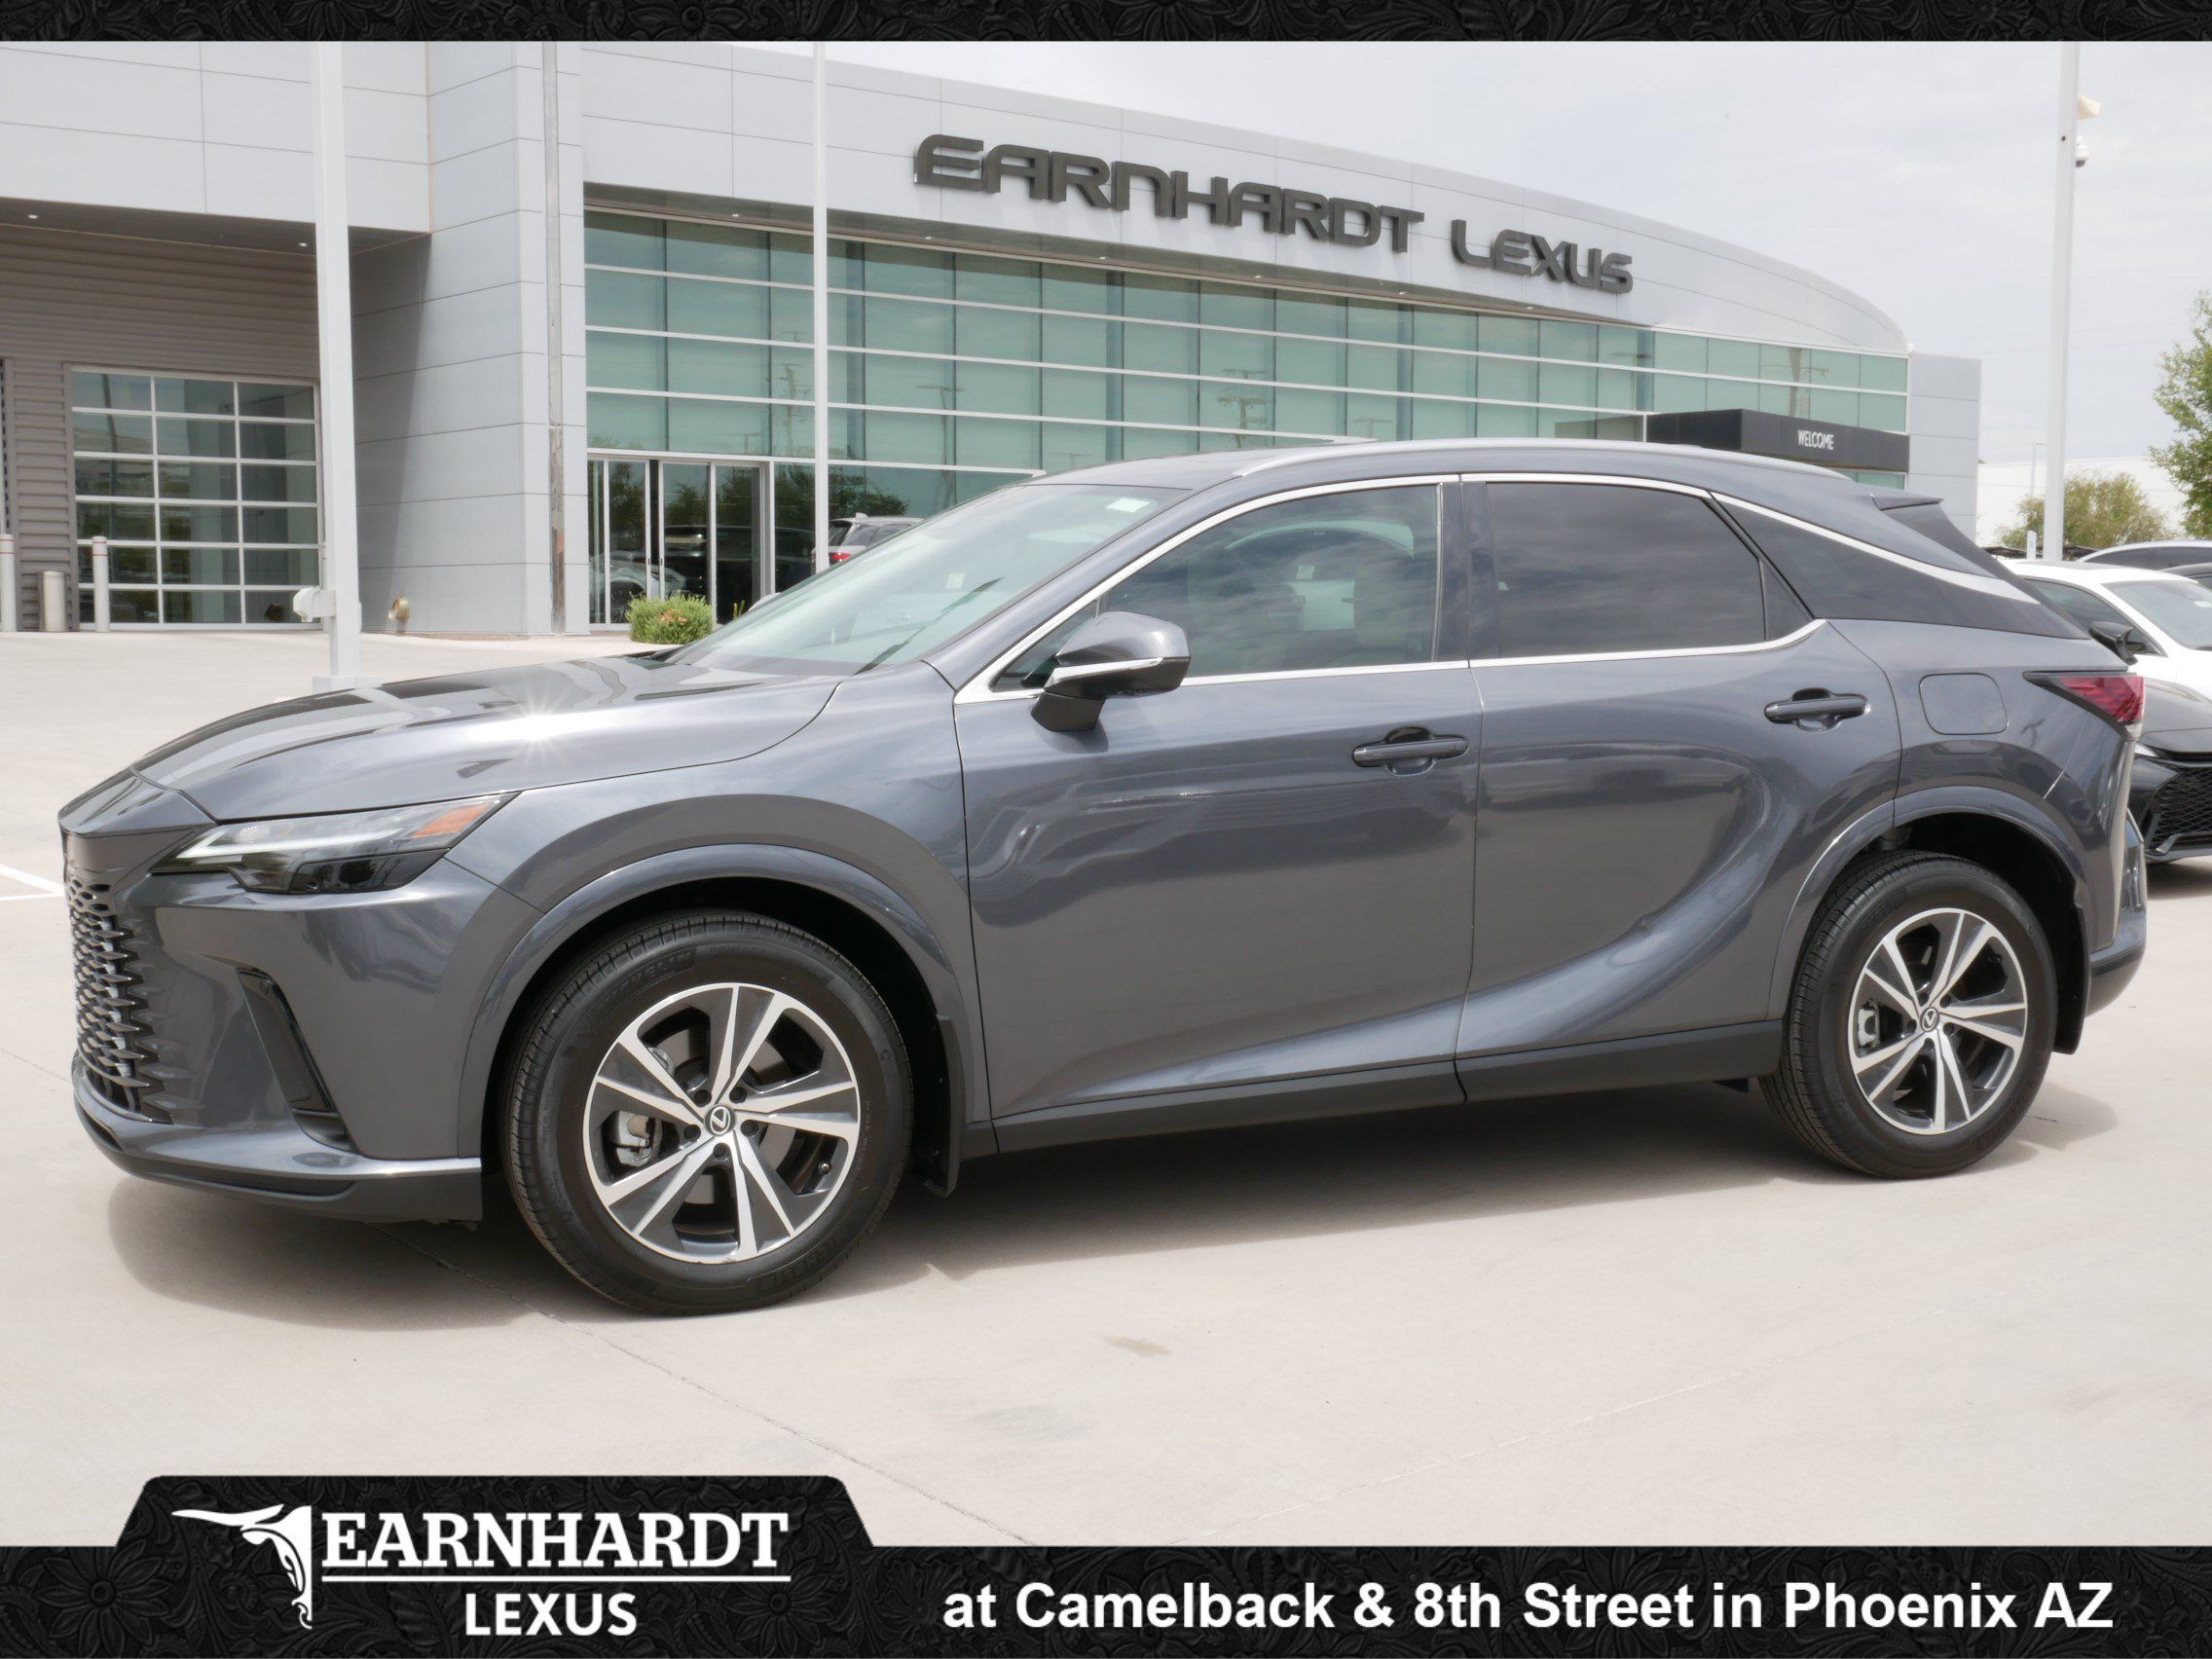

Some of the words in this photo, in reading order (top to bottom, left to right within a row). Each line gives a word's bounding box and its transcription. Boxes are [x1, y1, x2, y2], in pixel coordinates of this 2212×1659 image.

[913, 134, 1424, 254] EARNHARDT
[1451, 219, 1634, 294] LEXUS
[1797, 429, 1834, 451] WELCOME
